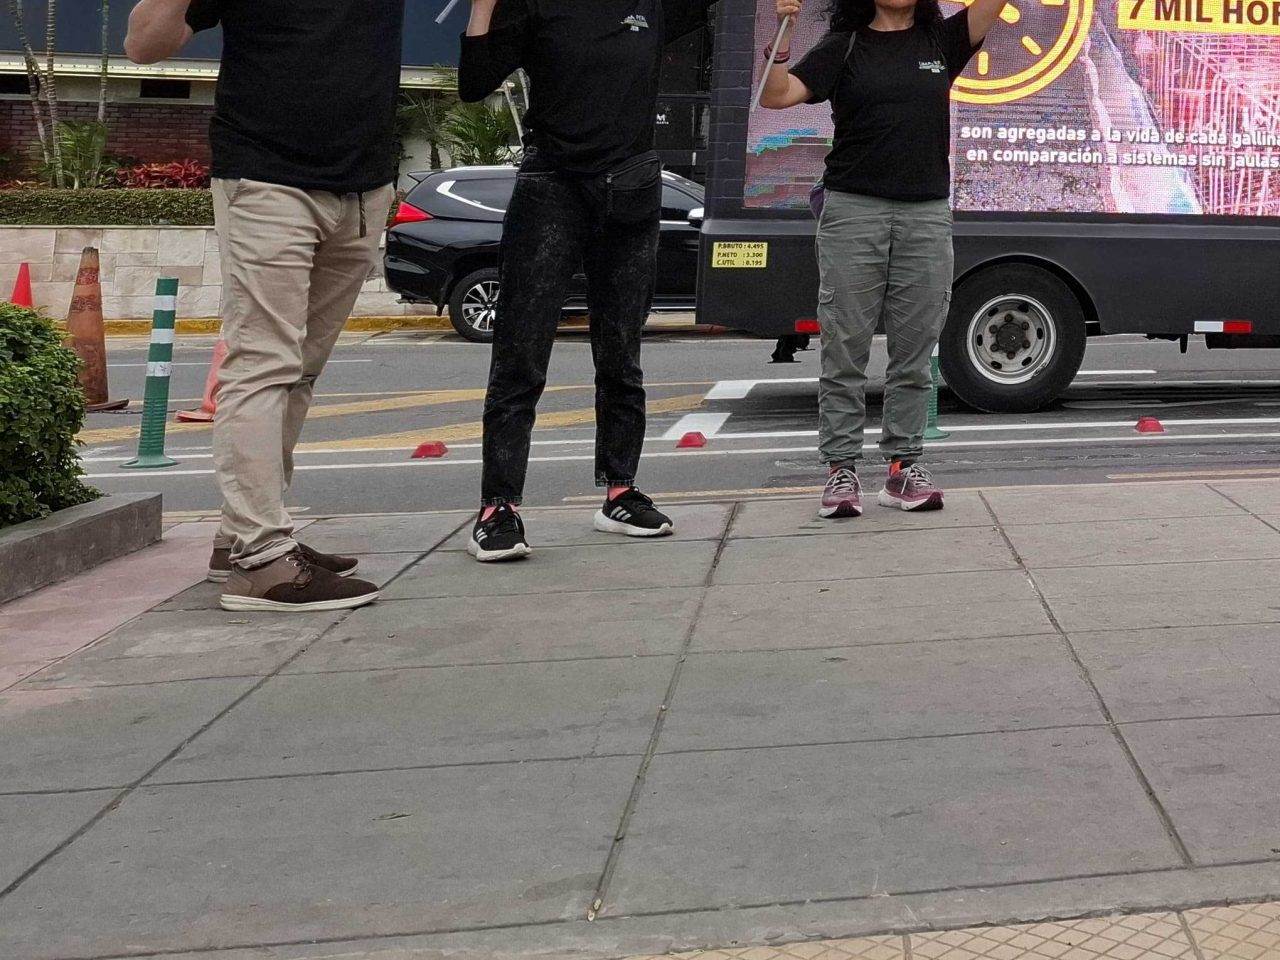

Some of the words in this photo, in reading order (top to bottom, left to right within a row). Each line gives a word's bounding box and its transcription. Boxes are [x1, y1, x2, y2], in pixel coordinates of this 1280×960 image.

[961, 127, 995, 139] son
[997, 125, 1086, 143] agregadas
[1091, 130, 1101, 142] a
[1106, 126, 1123, 142] la
[1126, 127, 1160, 143] vida
[1165, 128, 1185, 144] de
[1189, 128, 1227, 145] cada
[966, 150, 988, 162] en
[993, 146, 1103, 165] comparación
[1107, 153, 1117, 165] a
[1122, 150, 1197, 167] sistemas
[1201, 150, 1226, 167] sin
